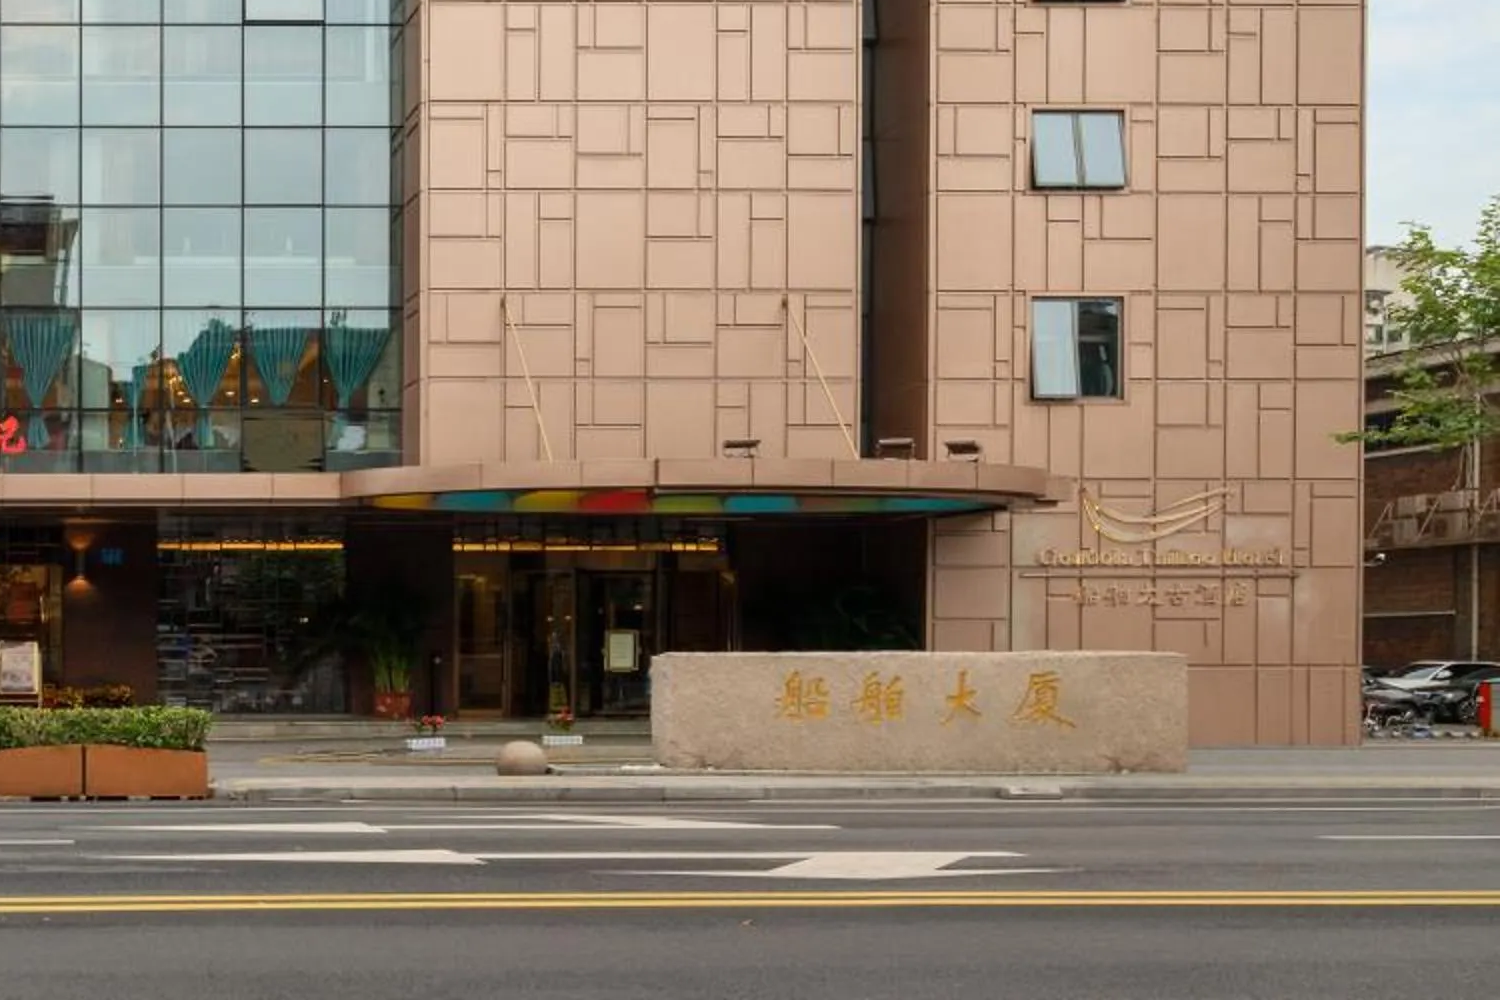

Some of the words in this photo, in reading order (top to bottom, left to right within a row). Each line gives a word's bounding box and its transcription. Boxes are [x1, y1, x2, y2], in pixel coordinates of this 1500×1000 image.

[1038, 548, 1132, 567] Gondola
[1223, 548, 1283, 567] Hotel
[775, 668, 1077, 730] 船舶大厦
